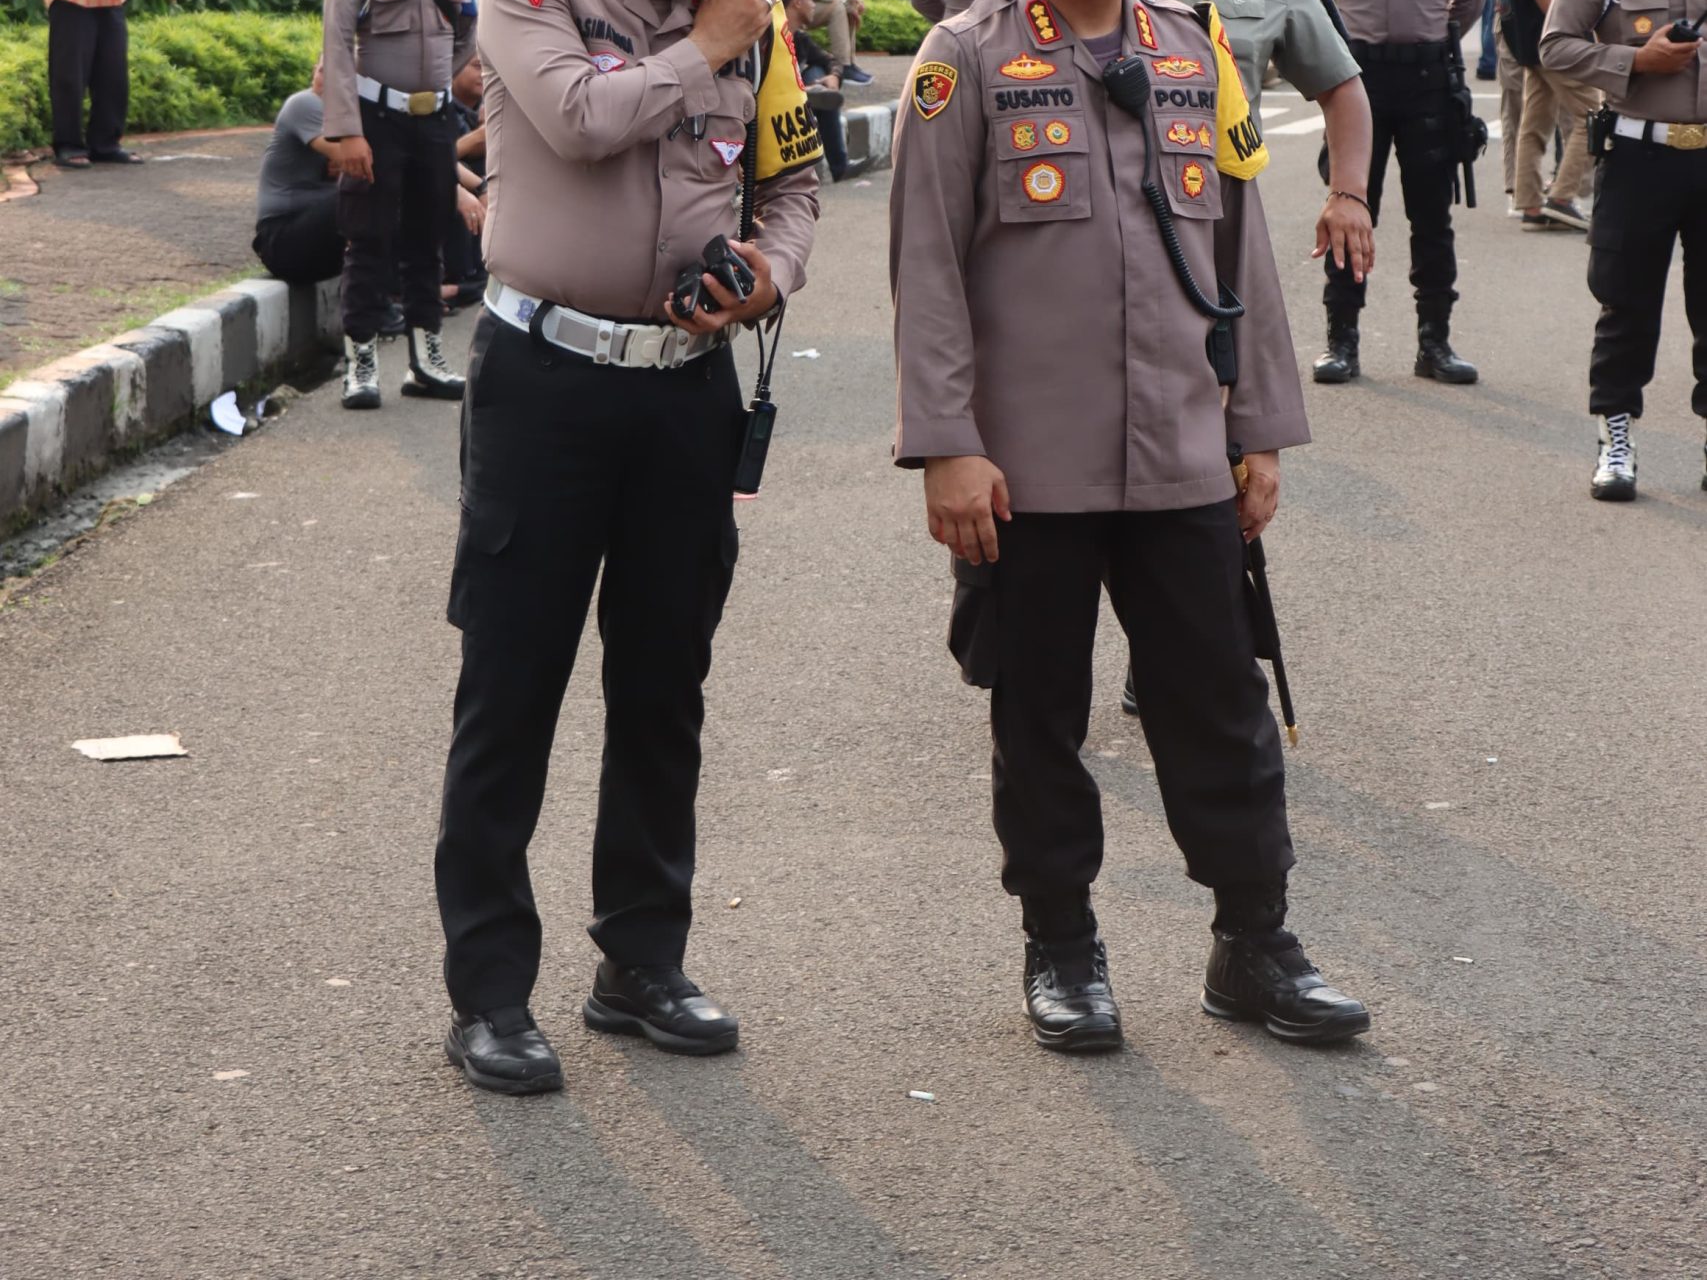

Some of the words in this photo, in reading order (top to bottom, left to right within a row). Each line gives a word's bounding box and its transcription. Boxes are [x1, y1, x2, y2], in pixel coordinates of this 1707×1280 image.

[995, 87, 1074, 112] SUSATYO
[1154, 88, 1216, 110] POLRI
[780, 144, 797, 163] OPS
